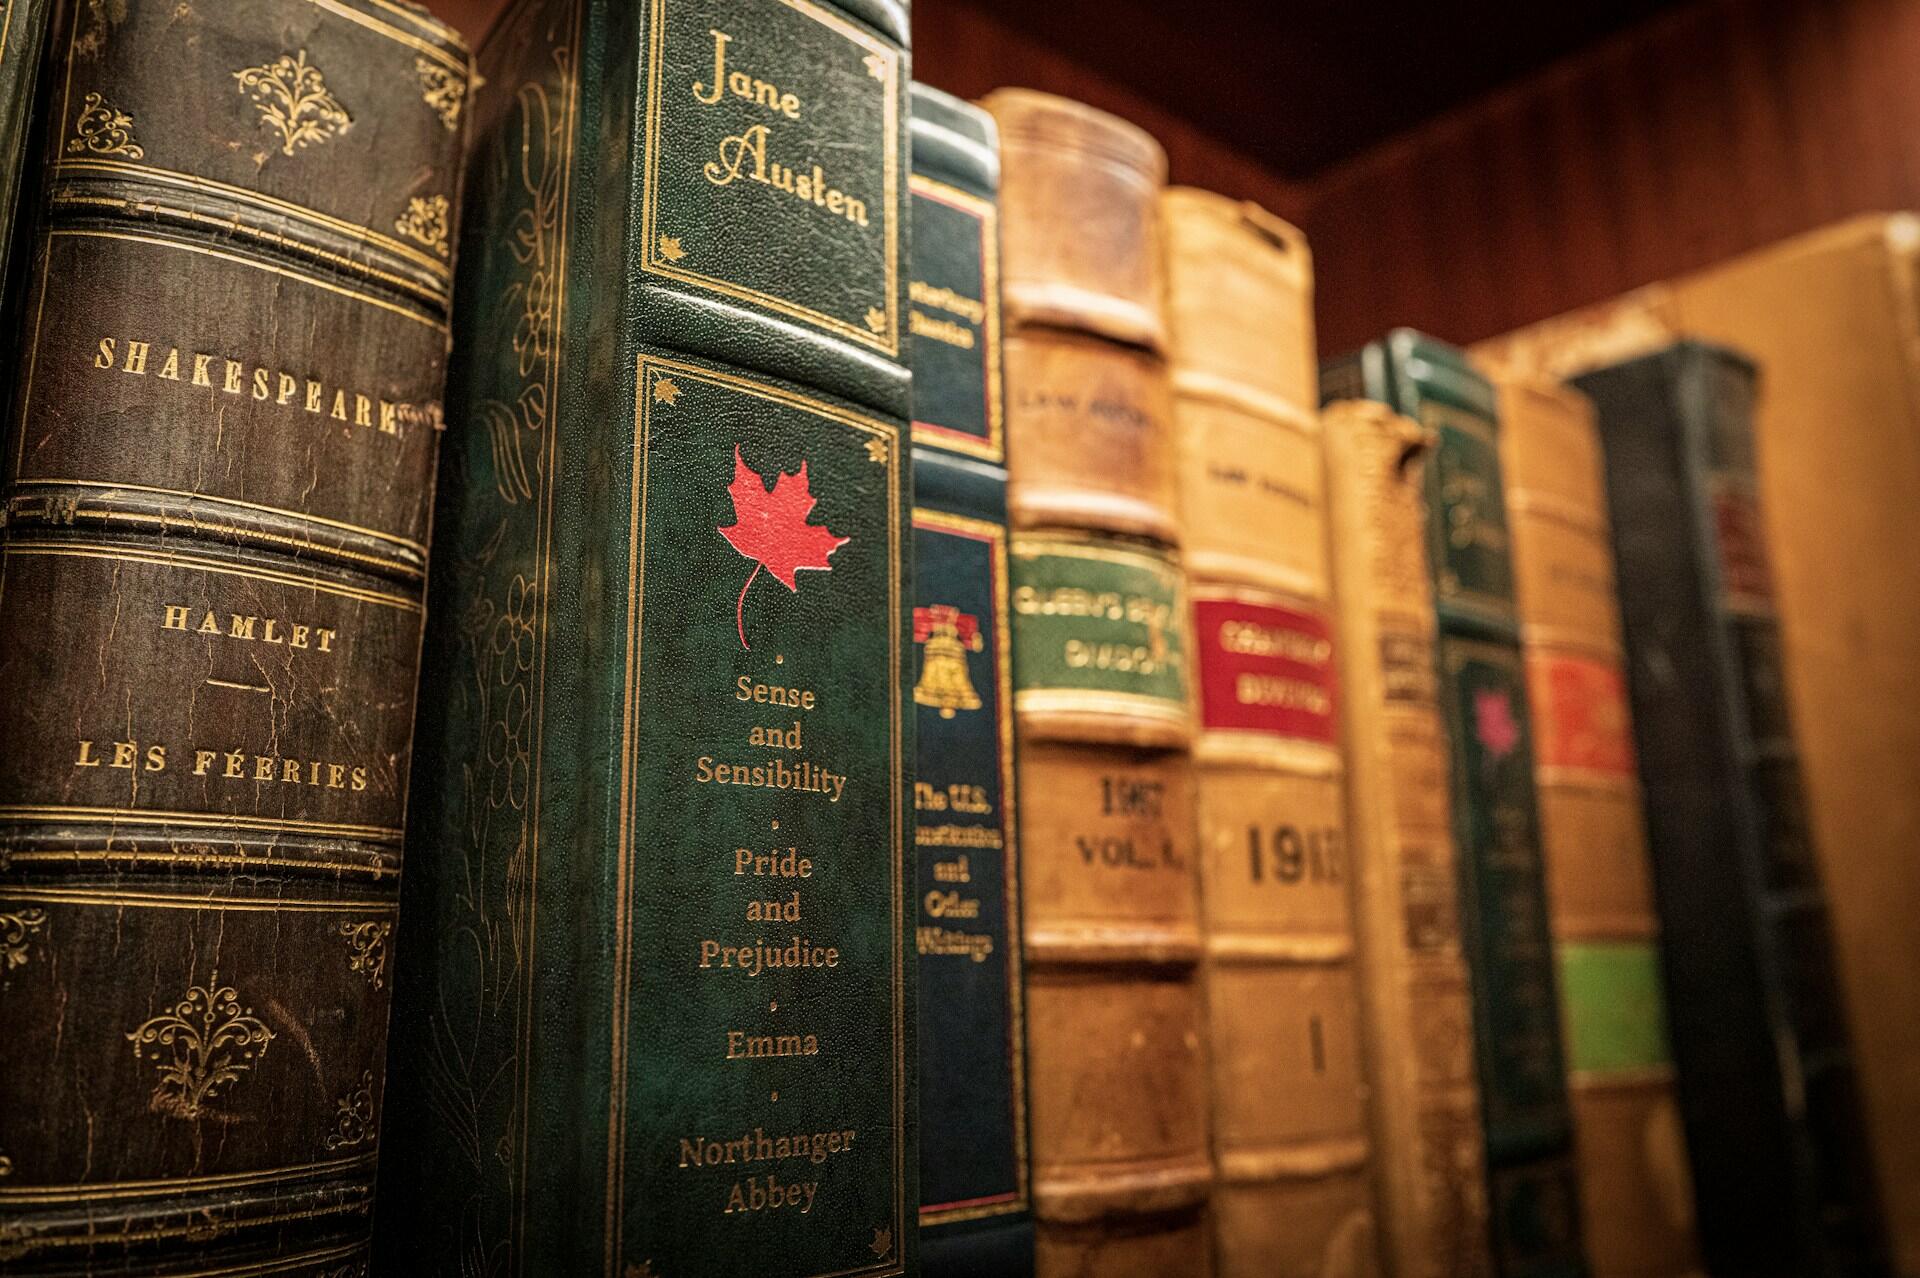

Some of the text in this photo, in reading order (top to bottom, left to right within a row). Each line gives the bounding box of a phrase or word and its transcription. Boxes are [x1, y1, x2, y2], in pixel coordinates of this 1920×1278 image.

[693, 29, 801, 118] Jane
[703, 124, 869, 227] Austen
[95, 337, 397, 435] SHAKESPEARE
[162, 604, 337, 653] HAMLET
[736, 675, 815, 710] Sense
[749, 721, 802, 750] and
[75, 740, 368, 792] LES FÉERIES
[696, 756, 847, 802] Sensibility
[734, 848, 813, 878] Pride
[746, 892, 801, 922] and
[700, 937, 840, 976] Prejudice
[726, 1031, 819, 1059] Emma
[679, 1128, 855, 1168] Northanger
[724, 1175, 818, 1214] Abbey
